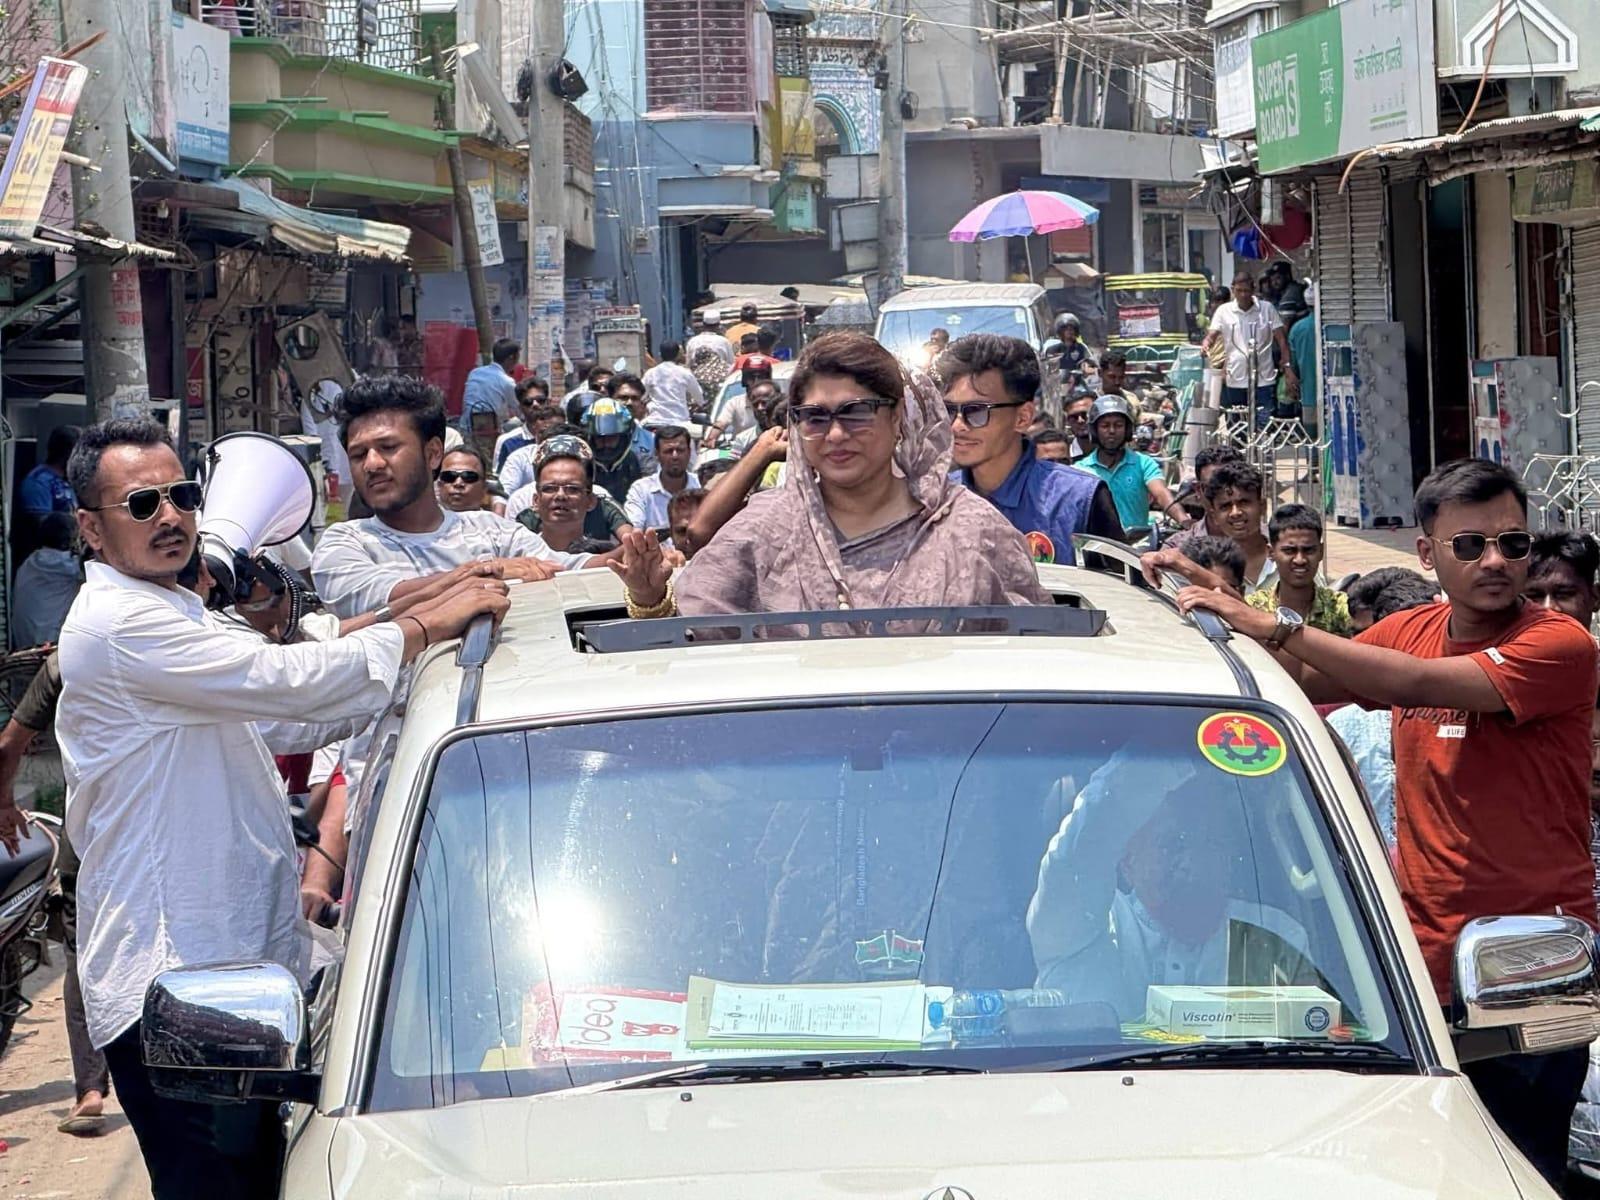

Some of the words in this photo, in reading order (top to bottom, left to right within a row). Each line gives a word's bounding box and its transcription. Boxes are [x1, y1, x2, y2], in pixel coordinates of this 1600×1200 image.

[1257, 60, 1284, 103] SUPER
[1260, 105, 1287, 144] BOARD
[567, 998, 619, 1047] idea
[1182, 1011, 1233, 1023] Viscotin
